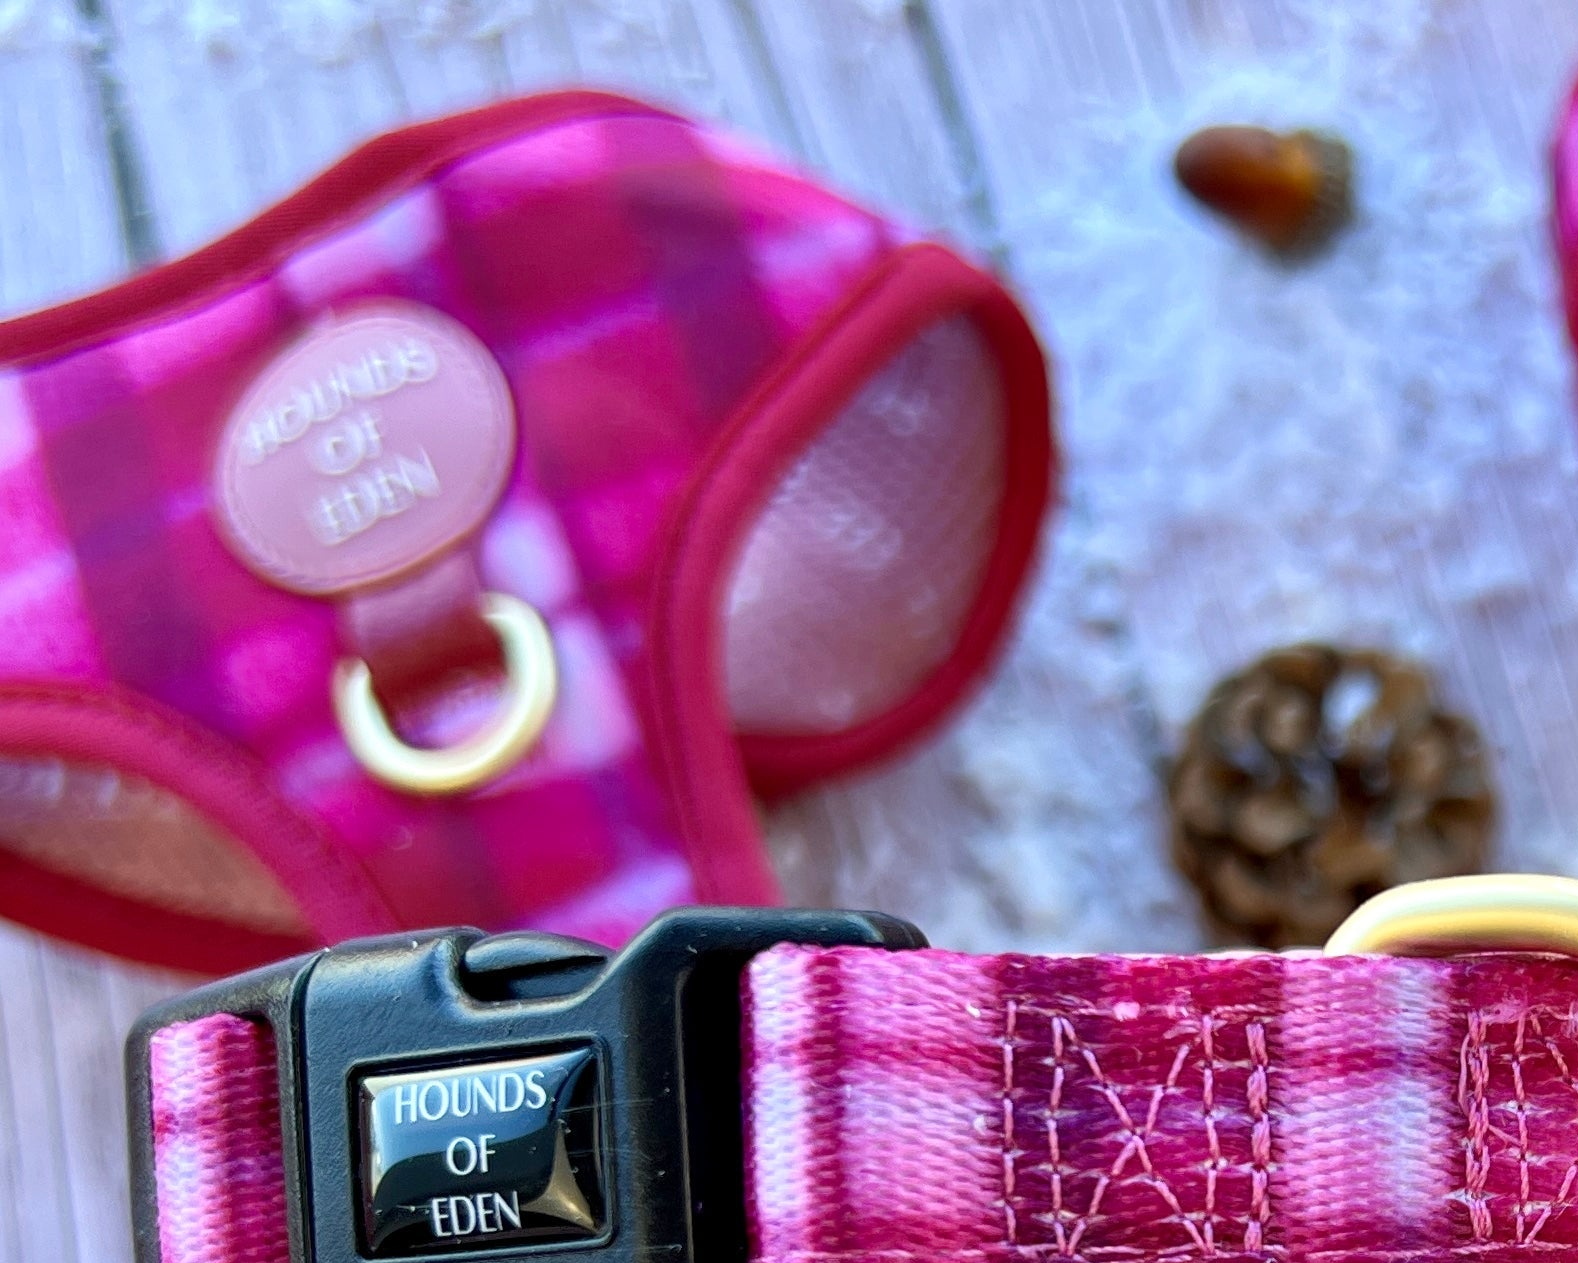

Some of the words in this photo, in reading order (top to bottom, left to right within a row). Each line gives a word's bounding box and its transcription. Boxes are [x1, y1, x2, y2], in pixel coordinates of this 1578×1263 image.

[238, 340, 437, 466] HOUNDS
[306, 412, 382, 474] OF
[310, 447, 441, 546] EDEN
[395, 1070, 547, 1124] HOUNDS
[446, 1134, 497, 1176] OF
[431, 1191, 522, 1237] EDEN
